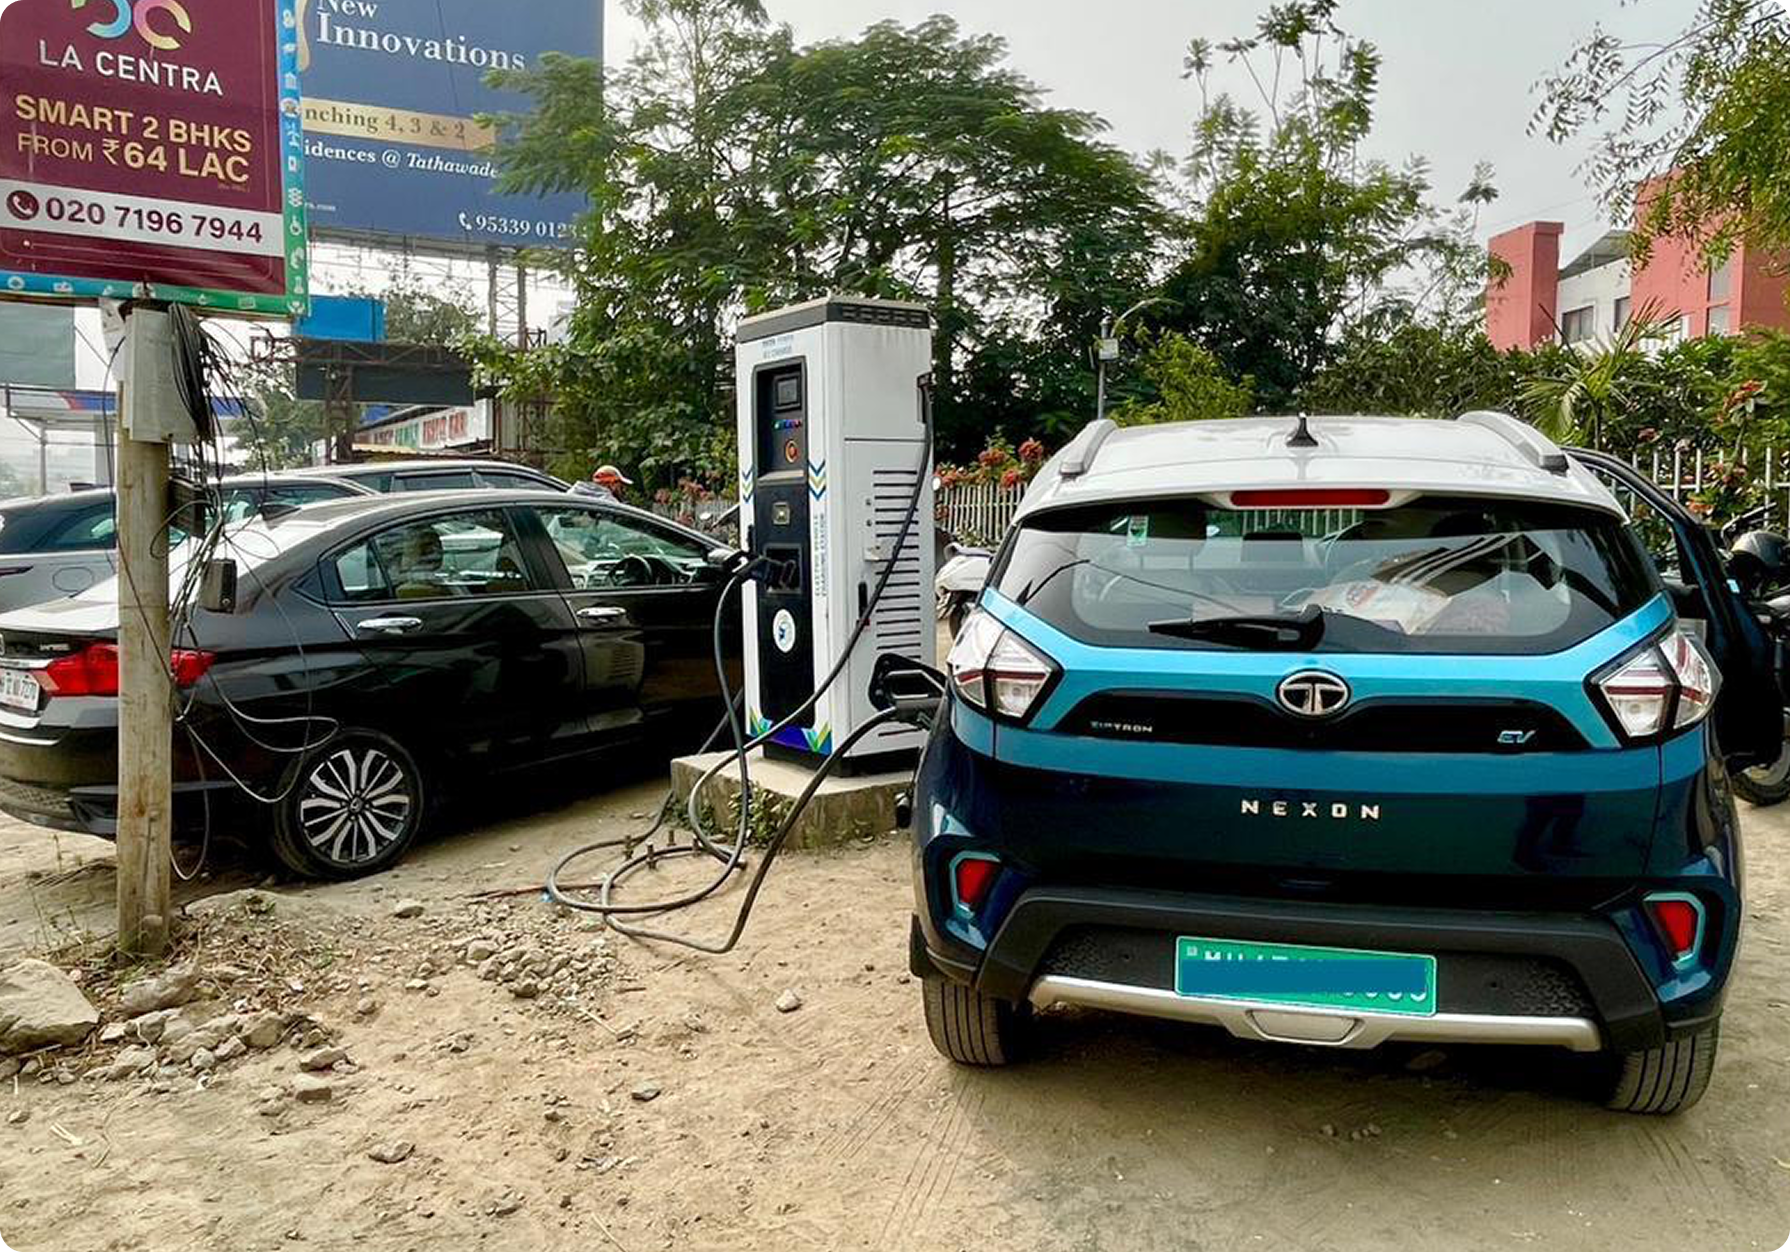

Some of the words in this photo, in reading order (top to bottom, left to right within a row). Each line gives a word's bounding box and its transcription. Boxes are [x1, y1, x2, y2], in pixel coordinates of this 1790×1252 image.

[316, 11, 527, 70] Innovations
[39, 39, 83, 71] LA
[95, 50, 224, 96] CENTRA
[15, 94, 133, 136] SMART
[142, 116, 160, 140] 2
[168, 119, 251, 153] BHKS
[409, 116, 422, 135] 3
[429, 121, 449, 137] &
[455, 123, 466, 140] 2
[17, 132, 93, 162] FROM
[178, 147, 250, 184] LAC
[304, 139, 376, 164] idences
[381, 149, 401, 168] @
[46, 197, 106, 226] 020
[114, 205, 184, 236] 7196
[191, 214, 263, 244] 7944
[475, 214, 531, 236] 95339
[1496, 729, 1537, 744] EV
[1241, 799, 1380, 820] NEXON
